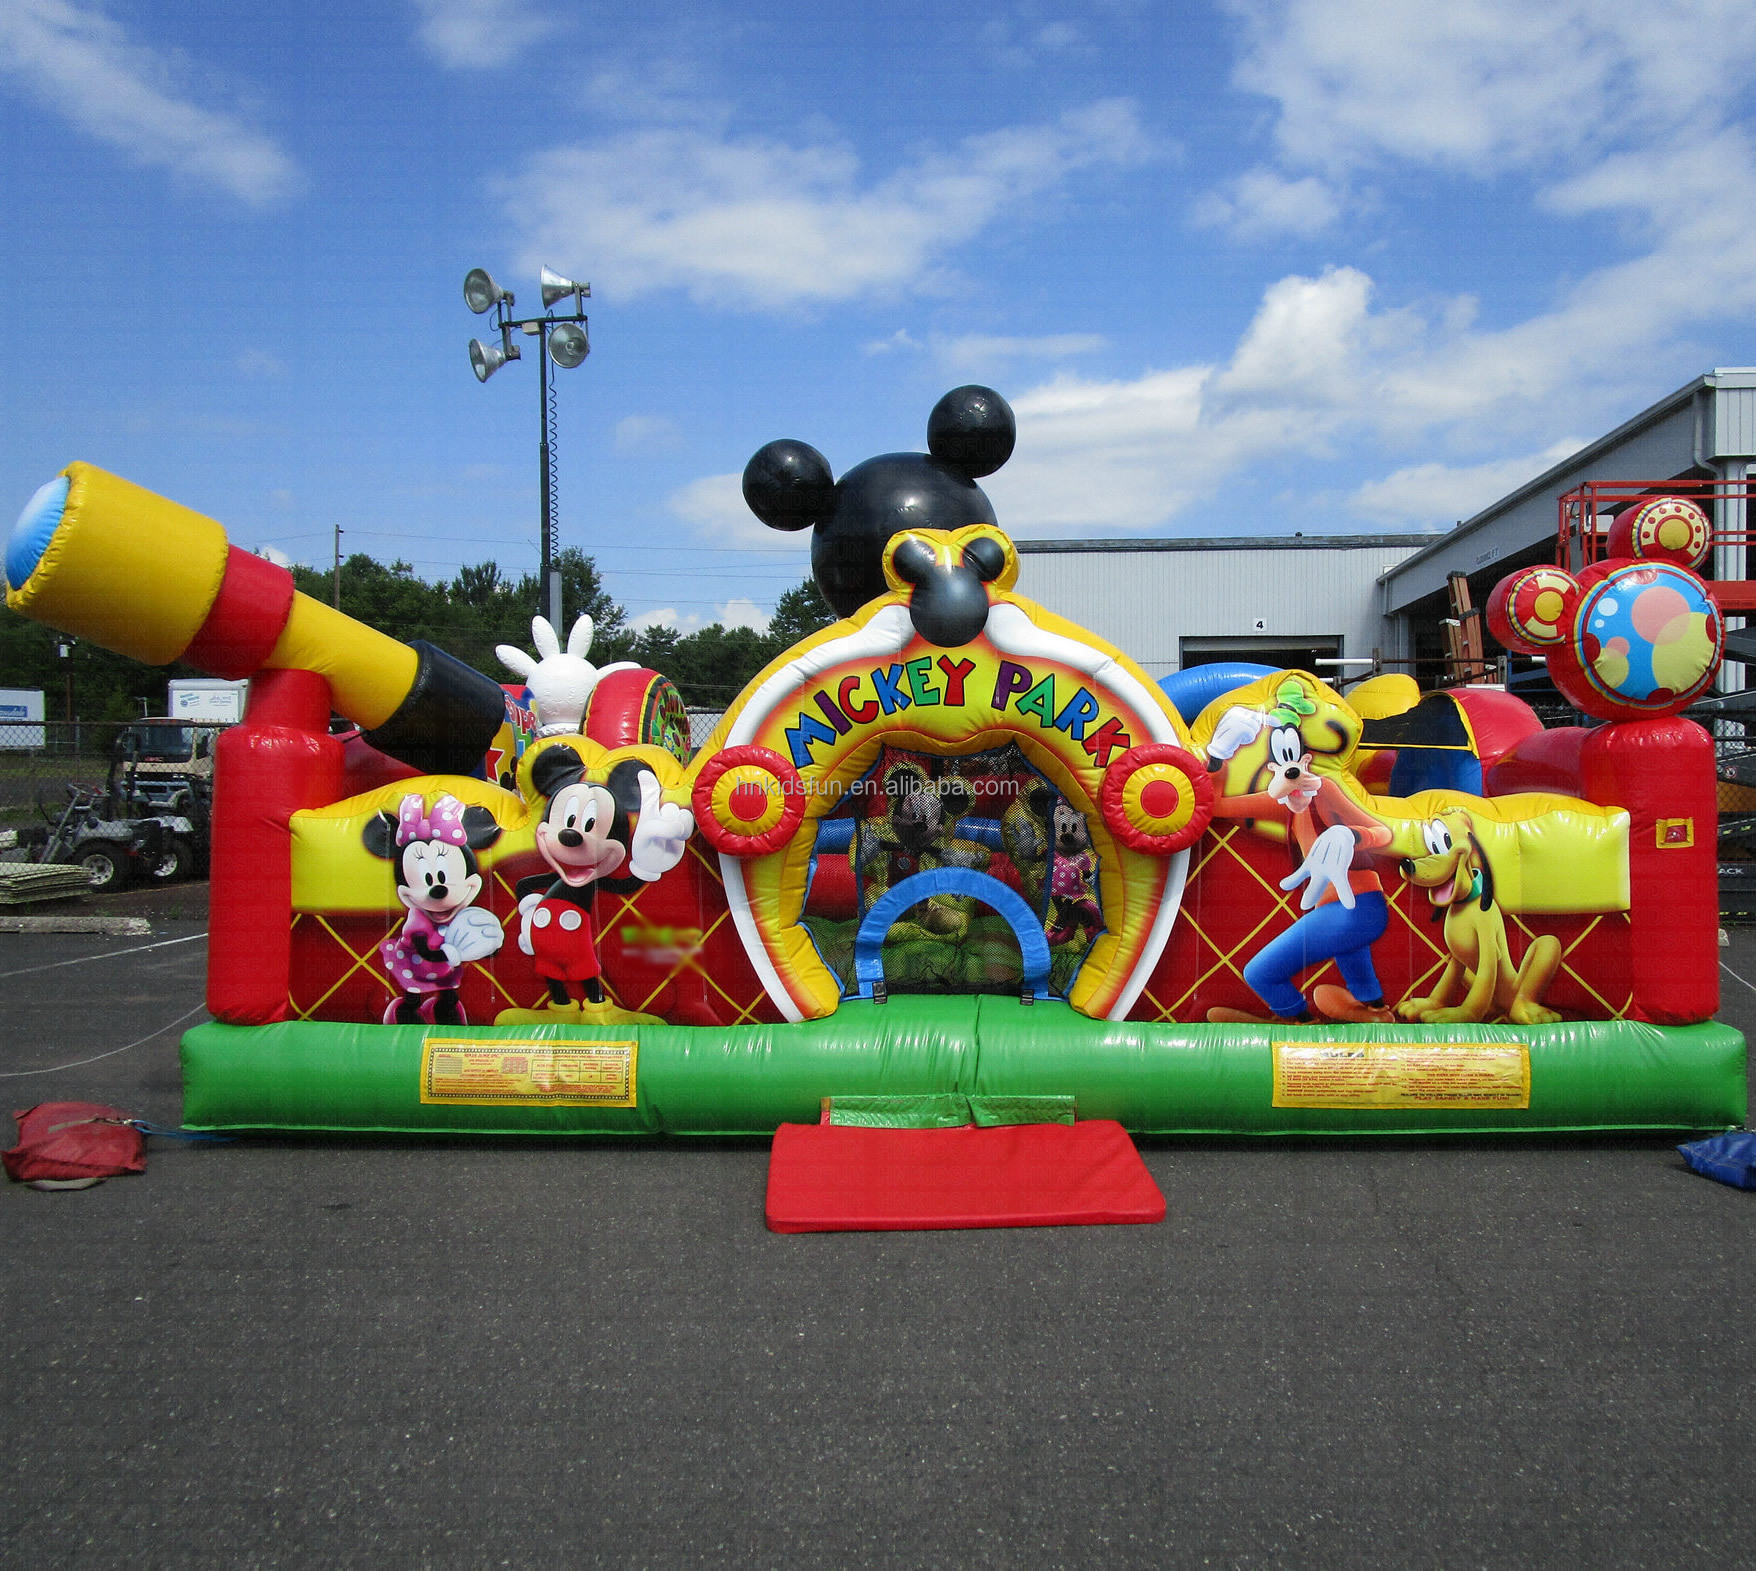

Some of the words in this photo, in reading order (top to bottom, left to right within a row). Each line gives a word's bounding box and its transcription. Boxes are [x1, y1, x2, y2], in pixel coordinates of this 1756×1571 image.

[1256, 620, 1264, 630] 4
[785, 654, 976, 769] MICKEY
[992, 660, 1130, 769] PARK
